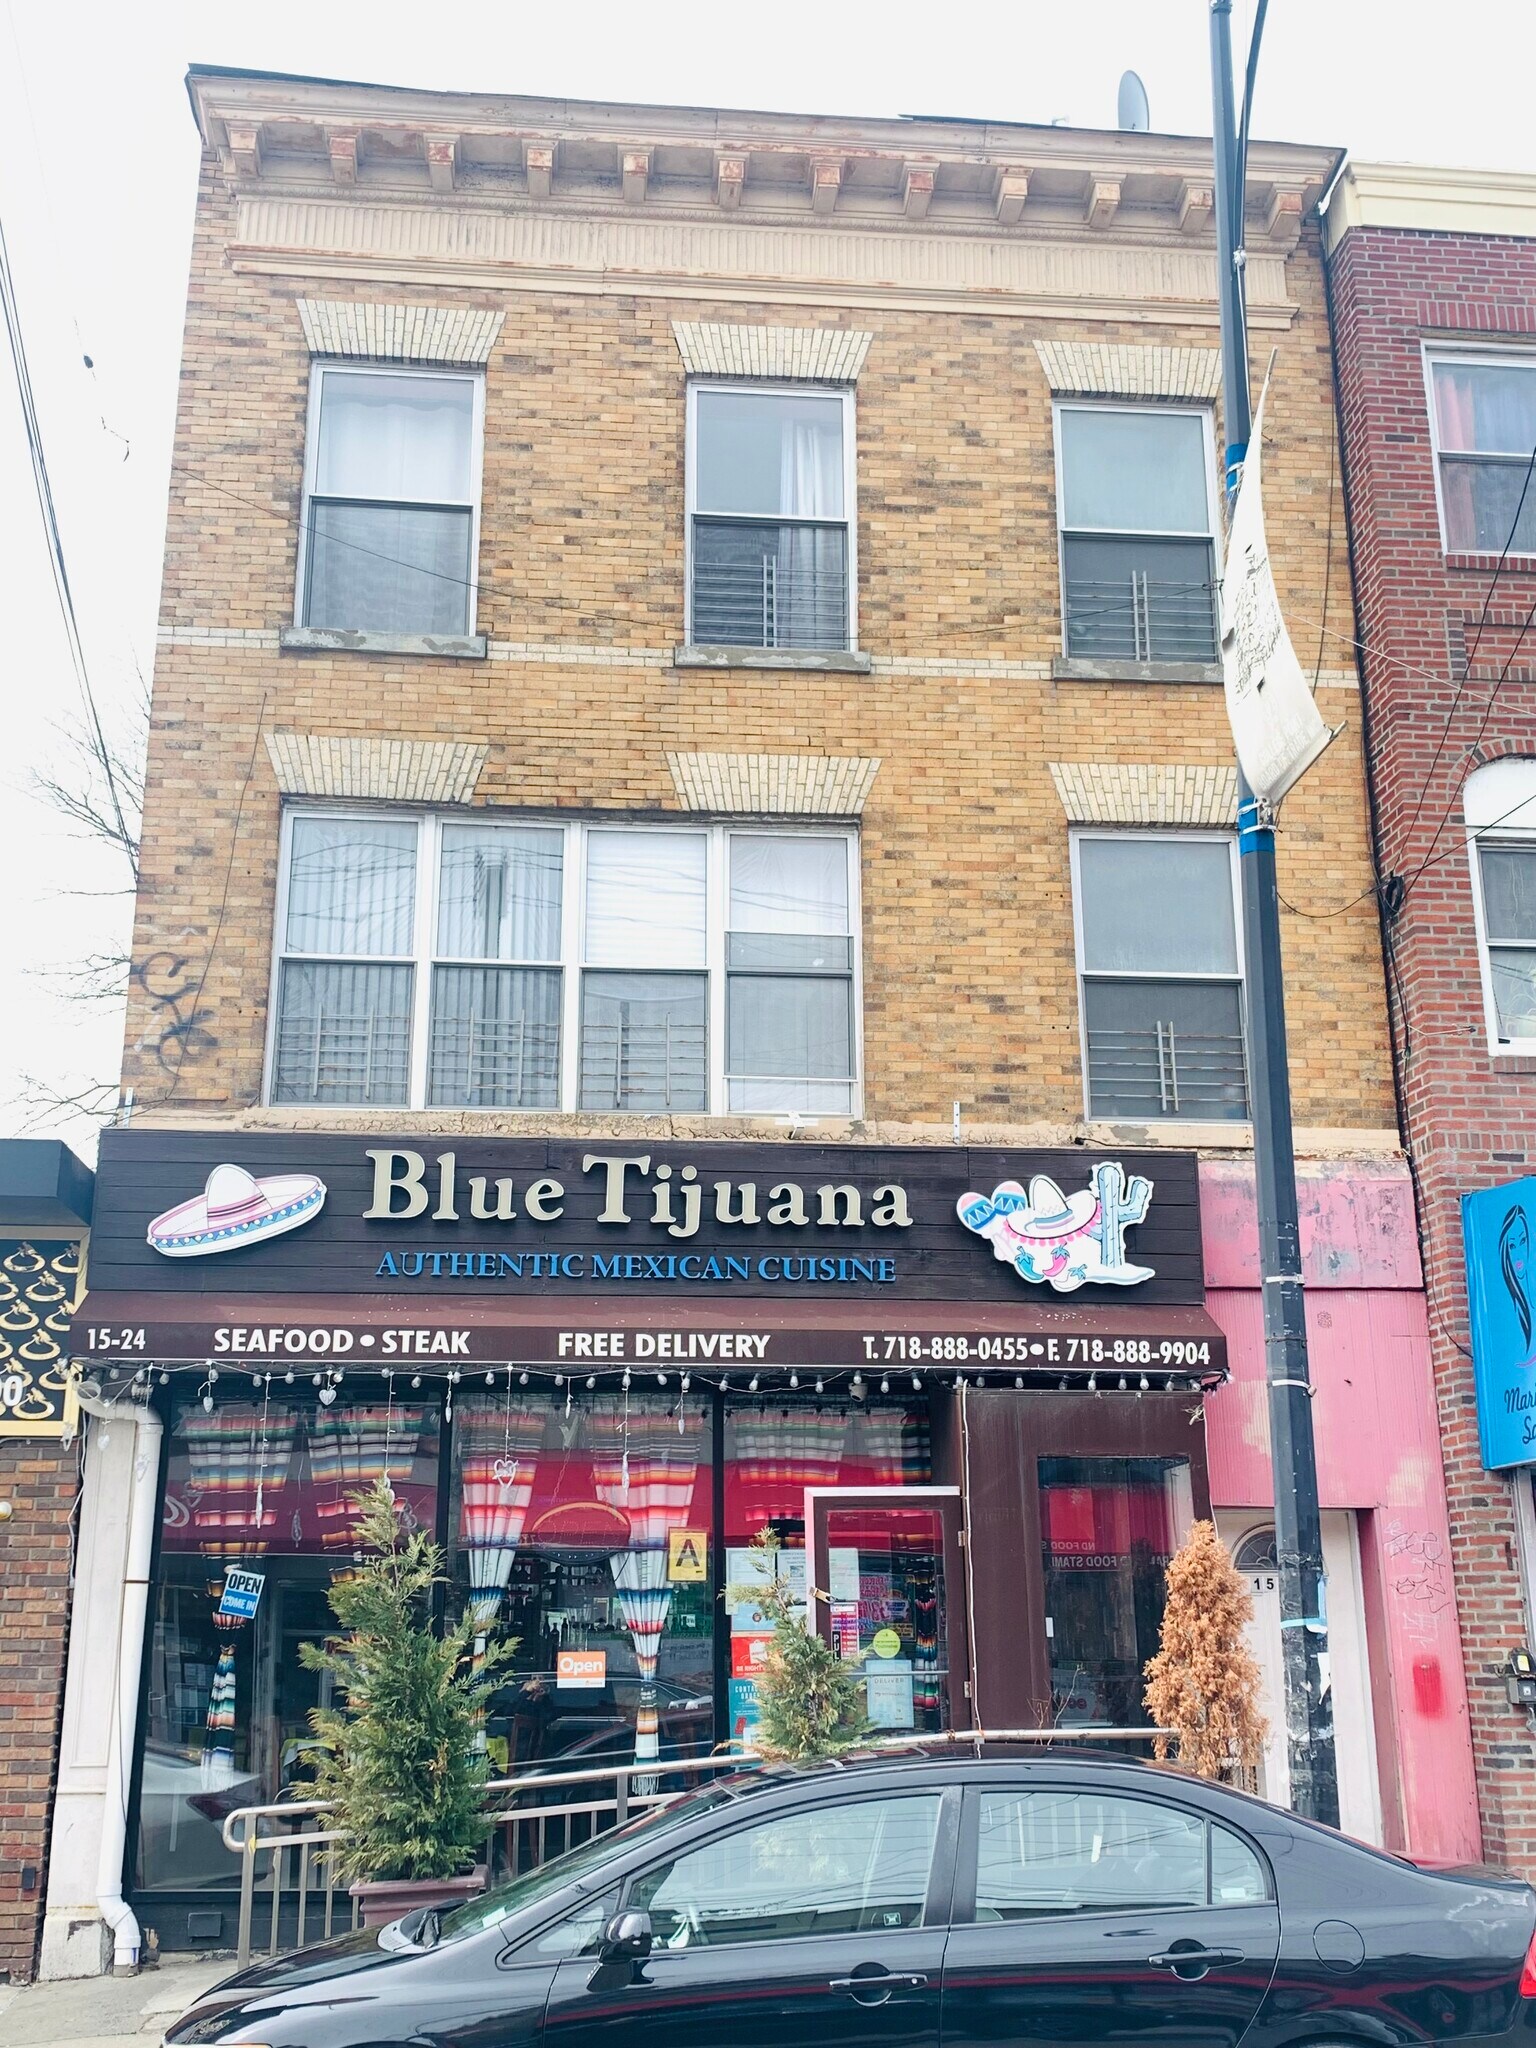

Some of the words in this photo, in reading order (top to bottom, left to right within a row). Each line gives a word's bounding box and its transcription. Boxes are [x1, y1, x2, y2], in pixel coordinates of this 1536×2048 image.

[362, 1149, 565, 1222] Blue
[582, 1152, 914, 1239] Tijuana
[374, 1250, 585, 1279] AUTHENTIC
[590, 1254, 753, 1281] MEXICAN
[757, 1255, 897, 1283] CUISINE
[87, 1328, 146, 1350] 15-24
[214, 1328, 354, 1354] SEAFOOD
[381, 1330, 471, 1355] STEAK
[558, 1332, 625, 1357] FREE
[635, 1333, 771, 1359] DELIVERY
[862, 1335, 879, 1359] T.
[883, 1336, 1029, 1361] 718-888-0455
[1066, 1338, 1211, 1365] 718-888-9904
[0, 1375, 23, 1407] 0
[675, 1538, 700, 1567] A
[228, 1573, 262, 1595] OPEN
[223, 1595, 247, 1610] COME
[245, 1600, 256, 1612] IN
[559, 1656, 603, 1677] Open
